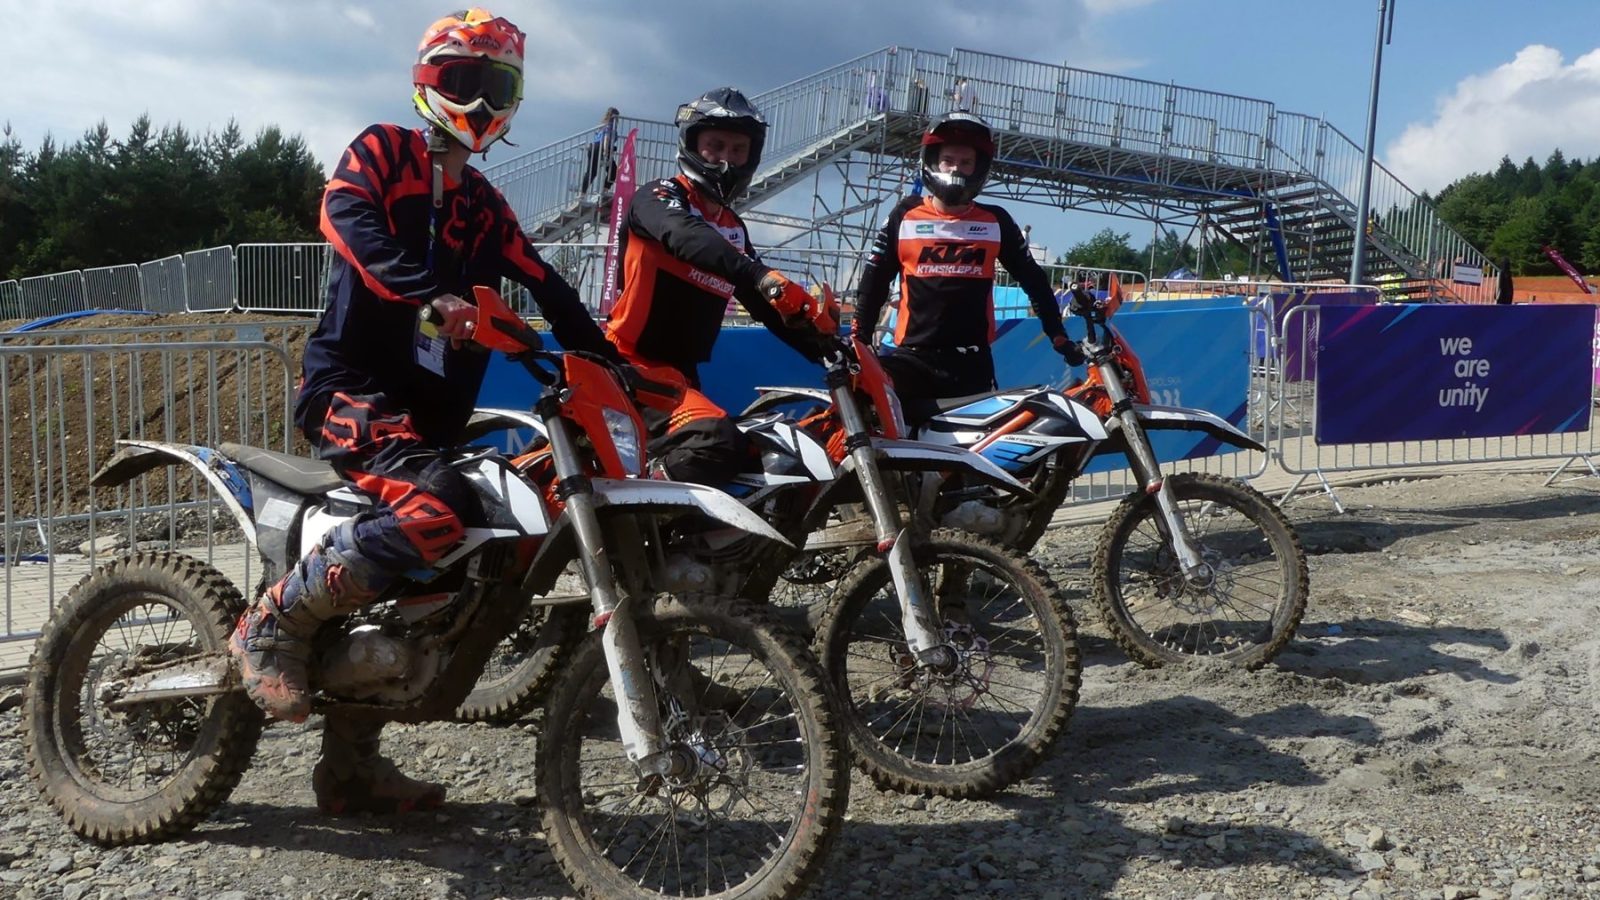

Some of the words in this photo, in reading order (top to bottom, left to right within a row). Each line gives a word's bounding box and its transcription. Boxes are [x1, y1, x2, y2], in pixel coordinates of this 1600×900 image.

[604, 259, 617, 300] Public
[611, 196, 624, 256] Entrance
[918, 242, 986, 265] KTM
[917, 264, 982, 275] KTMSKLEP.PL
[1439, 336, 1473, 356] we
[1454, 358, 1490, 378] are
[1438, 381, 1490, 412] unity
